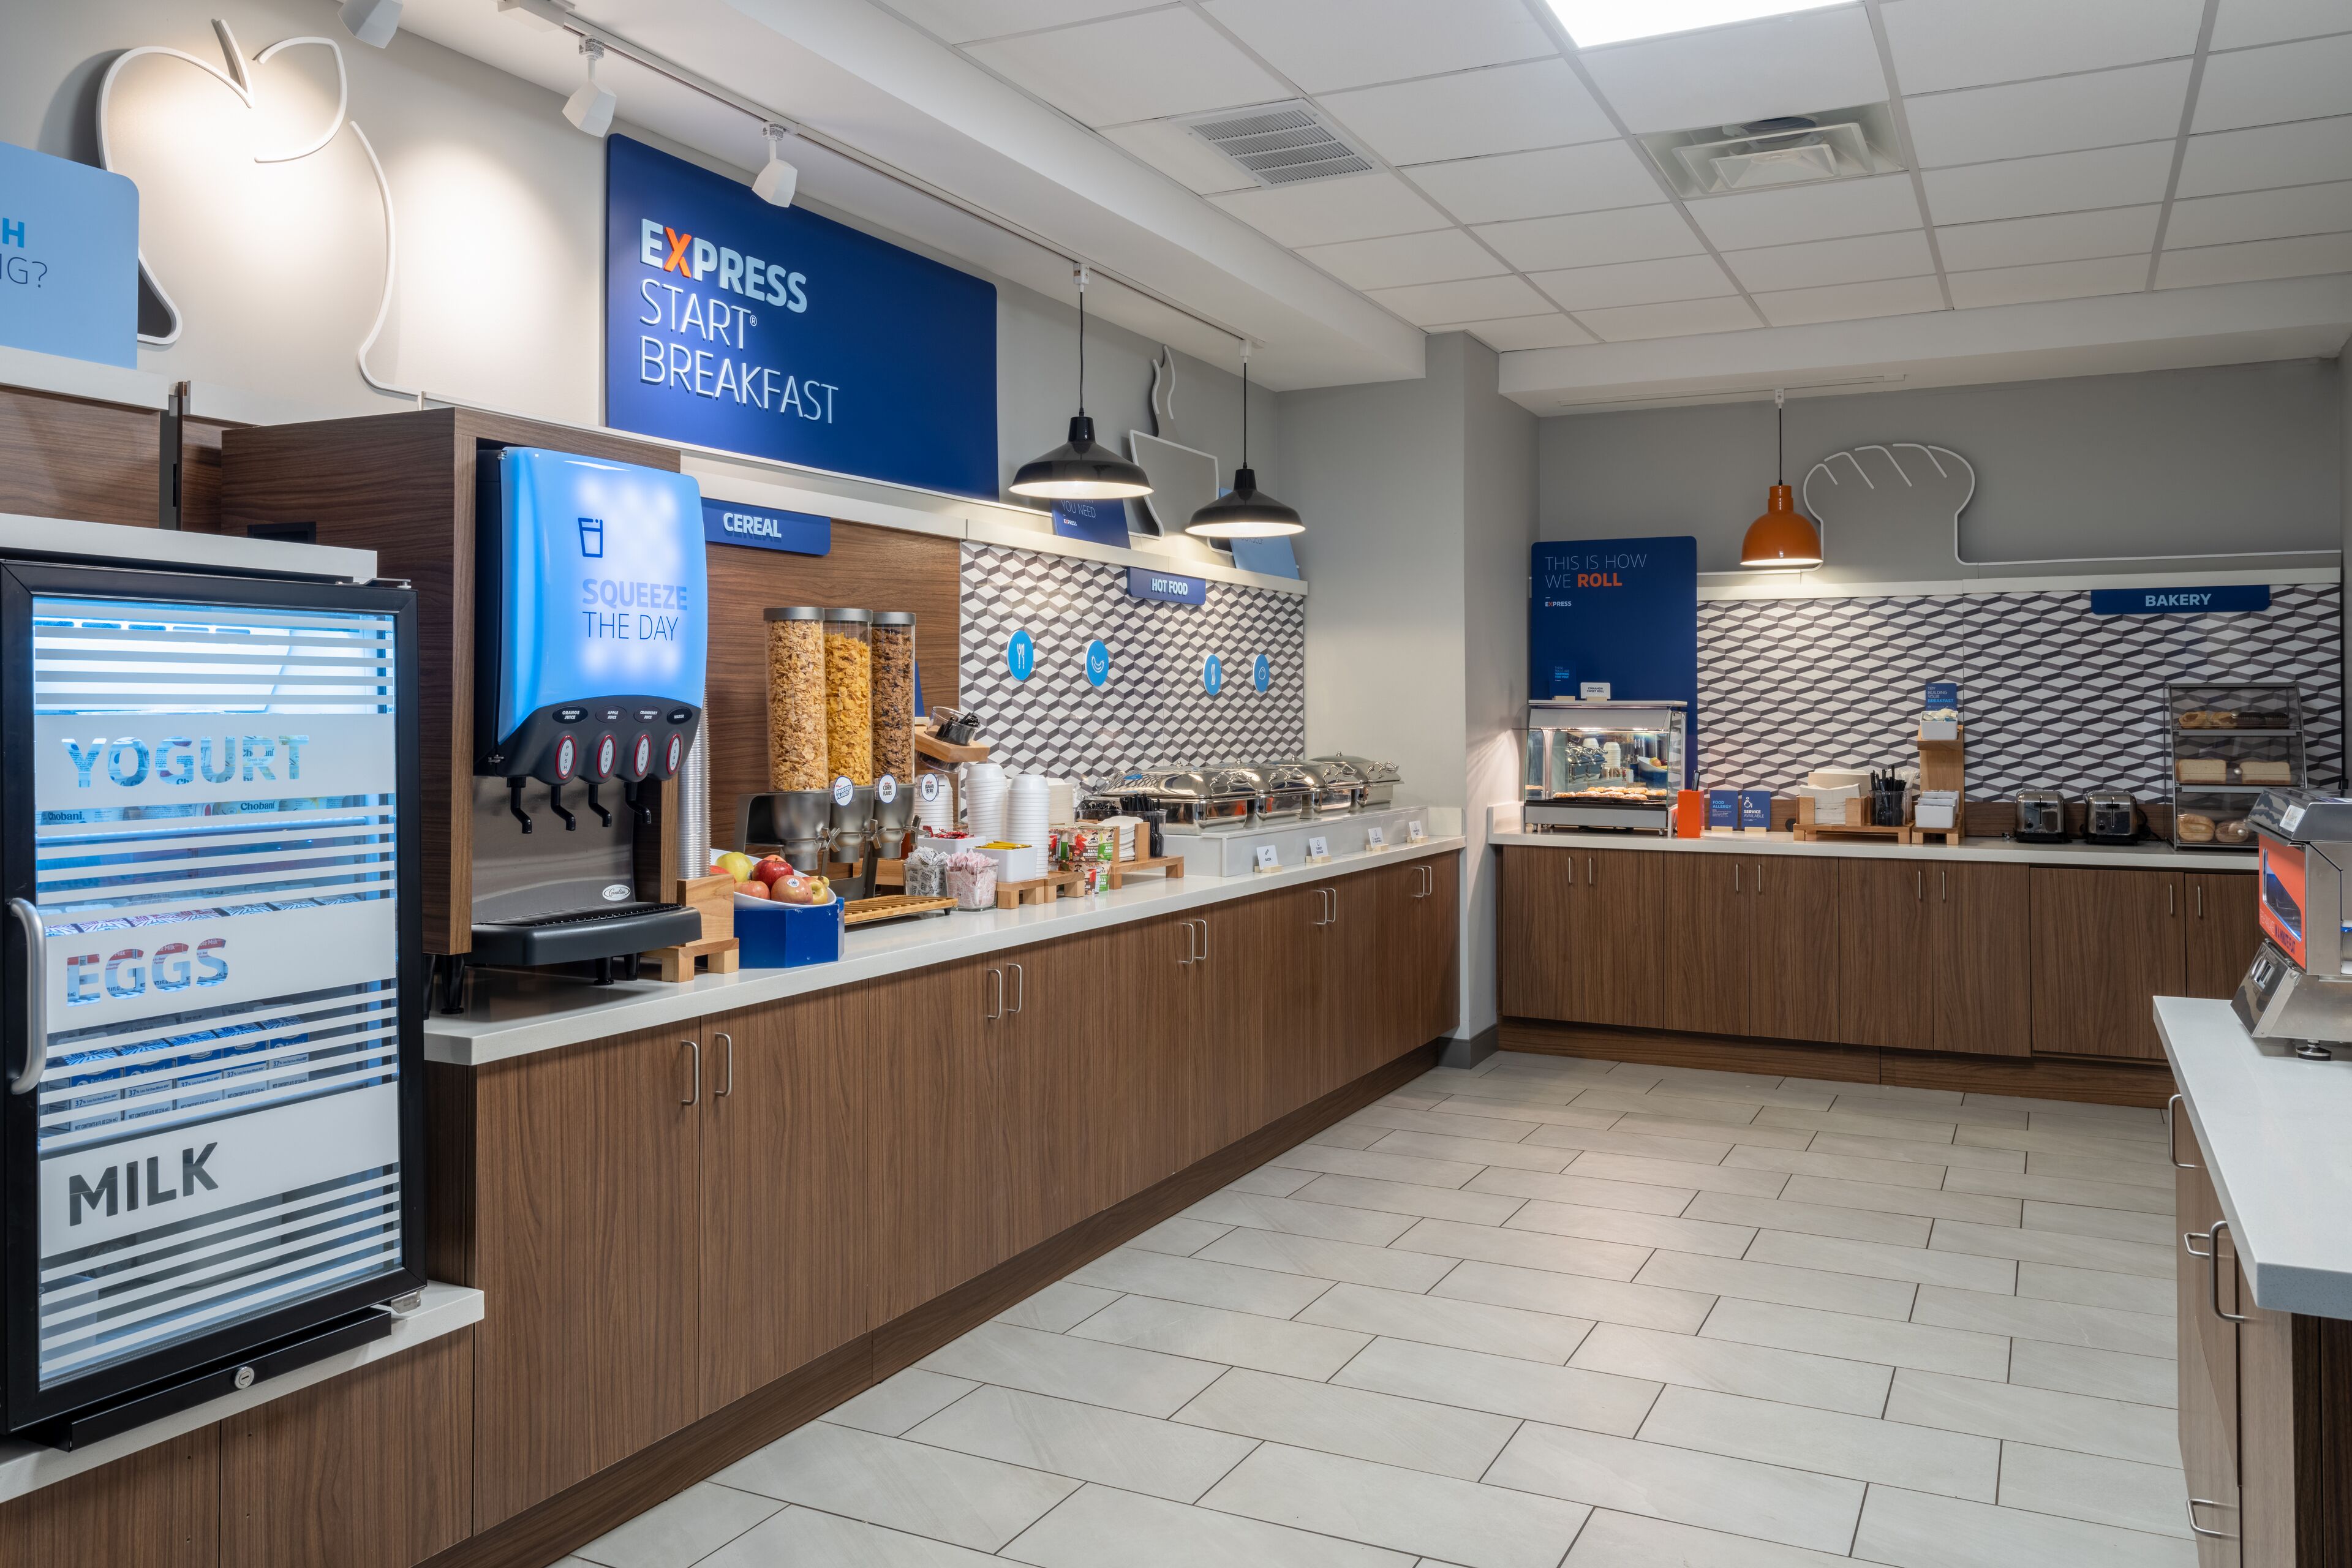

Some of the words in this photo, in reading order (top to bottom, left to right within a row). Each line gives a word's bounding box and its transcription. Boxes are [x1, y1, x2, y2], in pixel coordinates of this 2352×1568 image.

[0, 253, 47, 288] G?
[640, 218, 807, 314] EXPRESS
[640, 335, 839, 424] BREAKFAST
[1060, 499, 1076, 513] YOU
[1077, 503, 1096, 518] NEED
[723, 513, 782, 538] CEREAL
[1063, 518, 1077, 527] EXPRESS
[1545, 556, 1580, 571] THIS
[1586, 555, 1599, 570] IS
[1605, 553, 1647, 569] HOW
[1152, 578, 1167, 594] HOT
[1168, 580, 1189, 596] FOOD
[1545, 574, 1571, 589] WE
[1577, 572, 1623, 588] ROLL
[582, 578, 688, 611] SQUEEZE
[2145, 593, 2212, 607] BAKERY
[582, 611, 630, 639] THE
[639, 614, 679, 641] DAY
[61, 735, 309, 788] YOGURT
[836, 785, 851, 796] FROSTED
[66, 938, 229, 1008] EGGS
[69, 1141, 219, 1227] MILK
